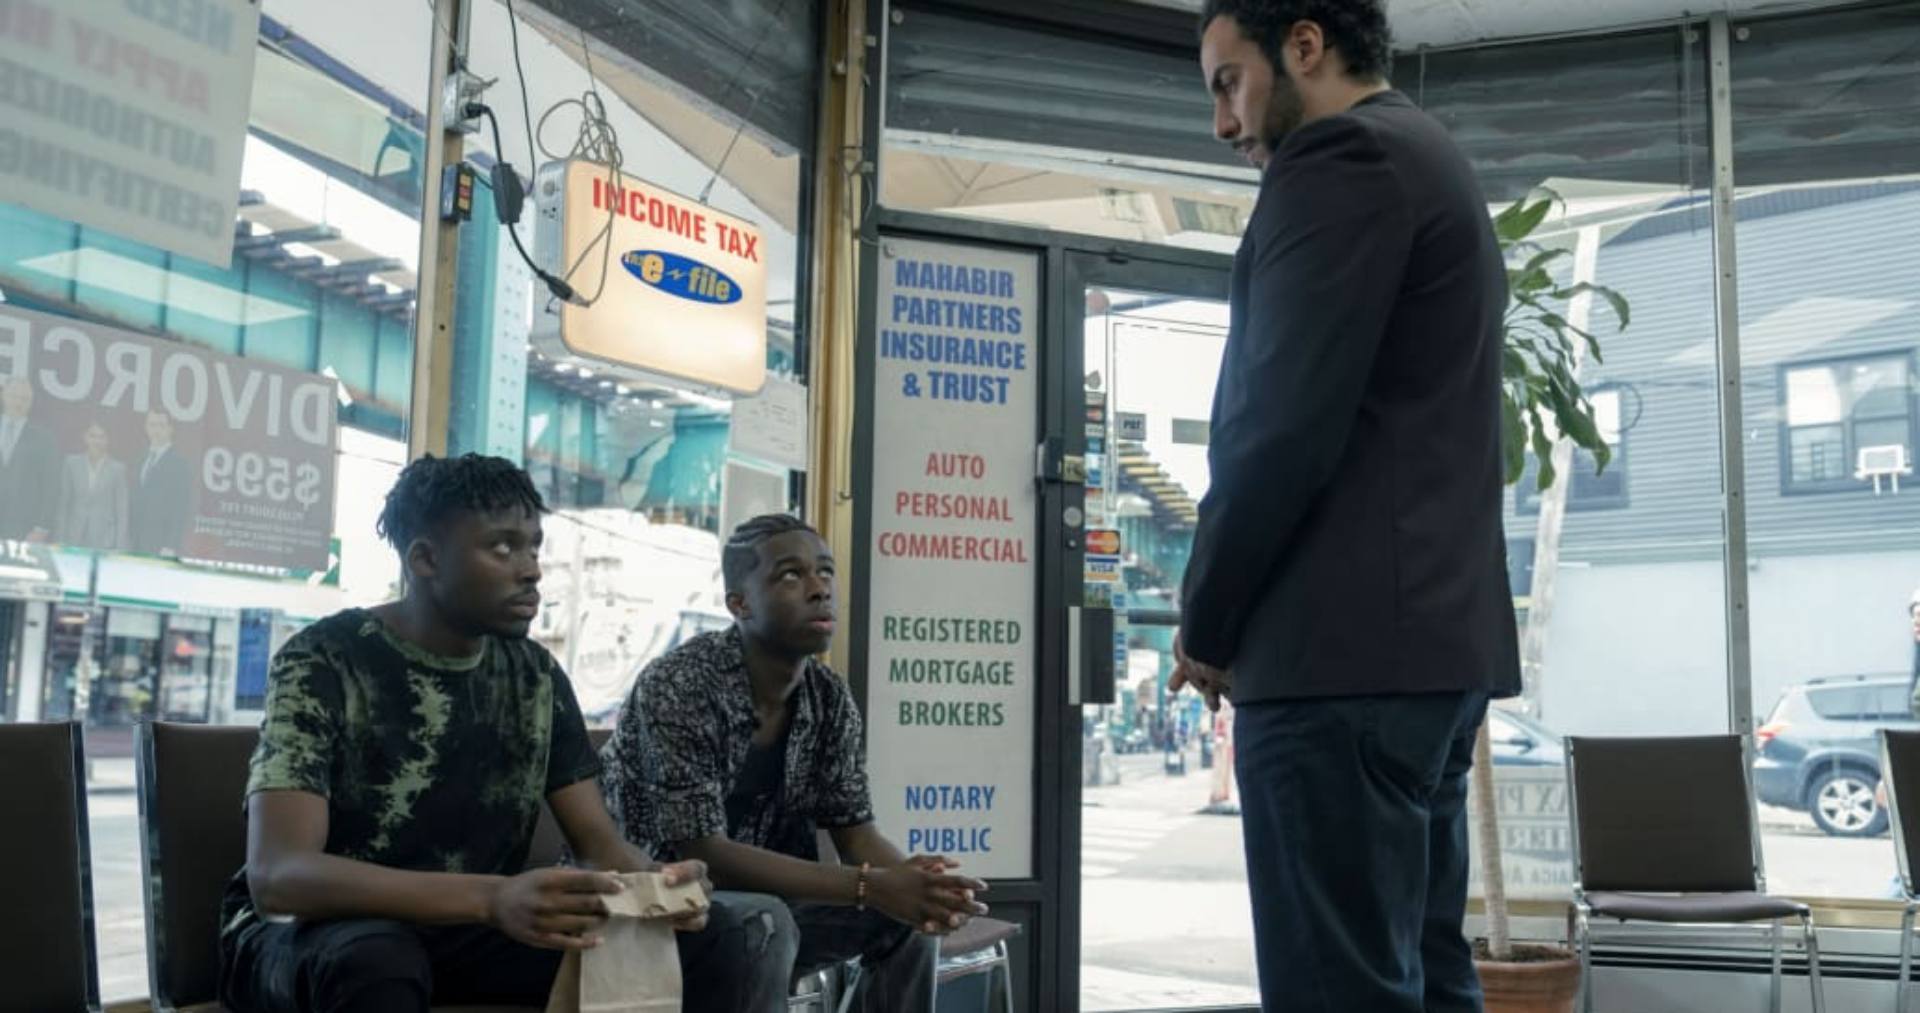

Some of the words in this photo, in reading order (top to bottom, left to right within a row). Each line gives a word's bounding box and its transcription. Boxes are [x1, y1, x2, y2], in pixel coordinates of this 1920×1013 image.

[592, 178, 706, 241] INCOME
[714, 223, 759, 263] TAX
[895, 259, 1015, 298] MAHABIR
[892, 295, 1022, 334] PARTNERS
[881, 331, 1026, 370] INSURANCE
[902, 372, 921, 398] &
[927, 371, 1010, 404] TRUST
[925, 452, 985, 479] AUTO
[895, 492, 1013, 522] PERSONAL
[878, 532, 1028, 563] COMMERCIAL
[883, 615, 1021, 644] REGISTERED
[889, 659, 1014, 685] MORTGAGE
[898, 702, 1004, 726] BROKERS
[905, 785, 995, 811] NOTARY
[908, 829, 991, 852] PUBLIC
